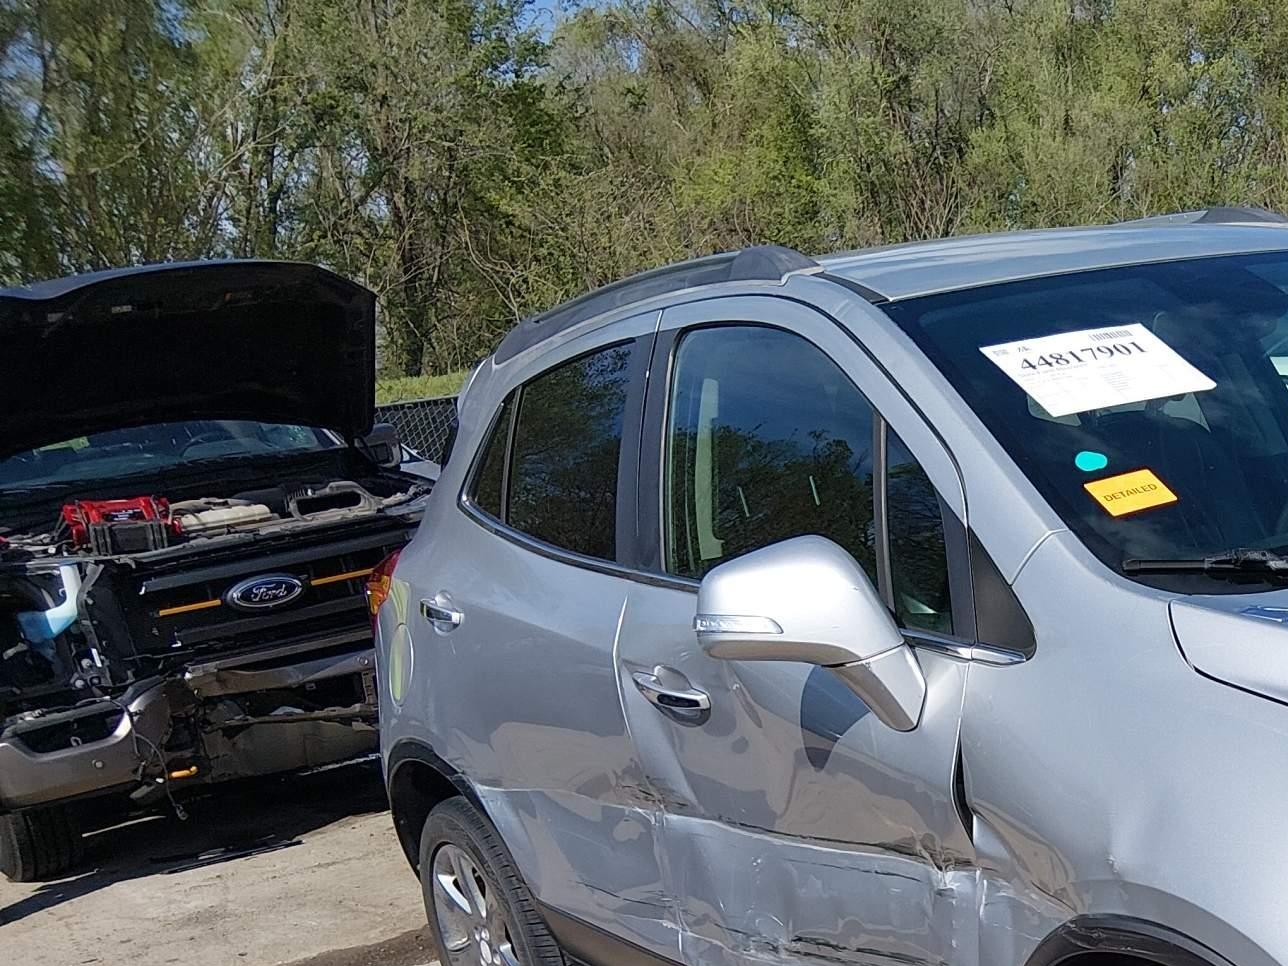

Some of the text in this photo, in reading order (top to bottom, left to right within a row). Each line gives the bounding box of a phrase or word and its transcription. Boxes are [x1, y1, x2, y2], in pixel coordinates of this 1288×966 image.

[1021, 341, 1147, 370] 44817901
[1103, 483, 1158, 502] DETAILED
[251, 583, 287, 602] Ford
